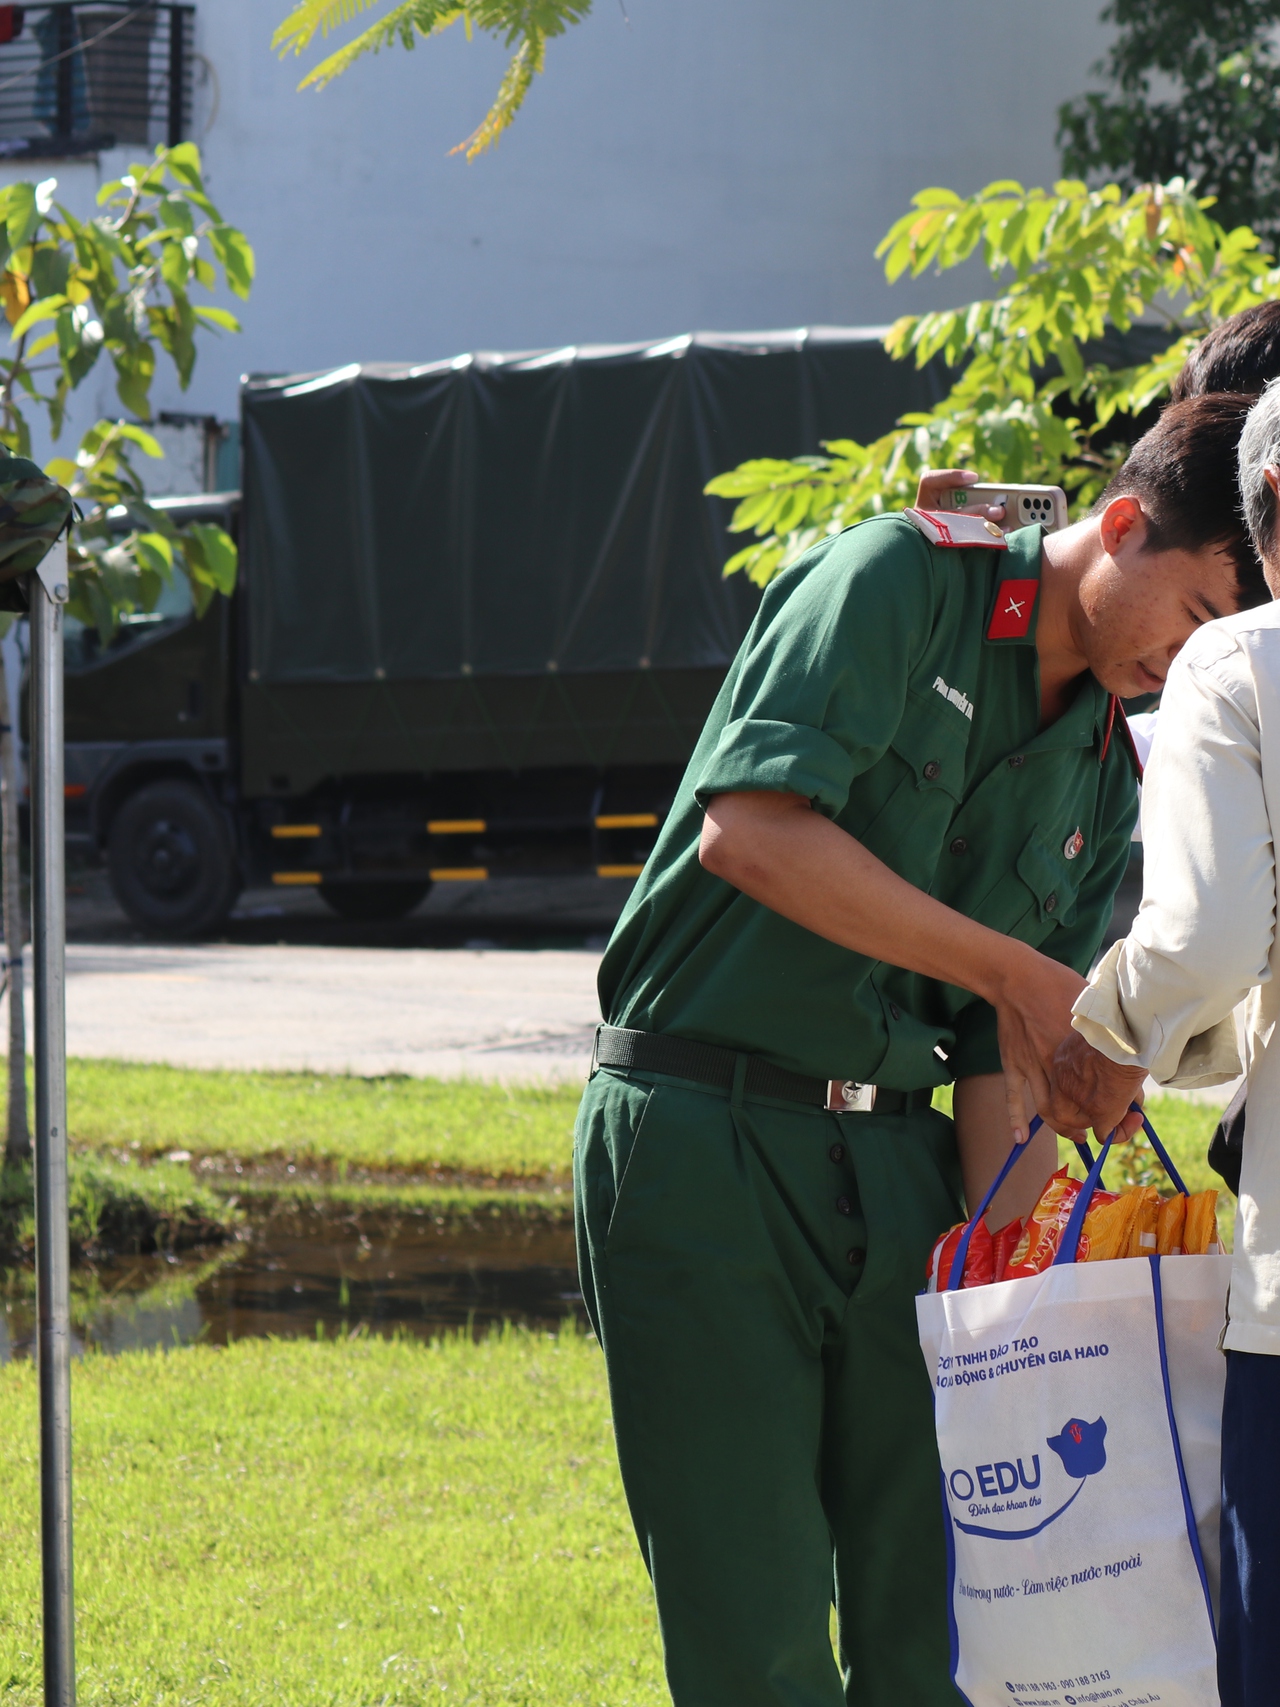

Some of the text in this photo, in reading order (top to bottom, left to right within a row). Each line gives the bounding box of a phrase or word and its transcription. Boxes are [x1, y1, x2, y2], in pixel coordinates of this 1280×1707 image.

[955, 1350, 988, 1367] TNHH
[989, 1343, 1009, 1360] ĐÀO
[1012, 1336, 1039, 1353] TẠO
[955, 1369, 987, 1386] ĐỘNG
[988, 1367, 995, 1379] &
[995, 1353, 1046, 1376] CHUYÊN
[1048, 1349, 1073, 1363] GIA
[1074, 1343, 1109, 1360] HAIO
[975, 1454, 1041, 1497] EDU
[1006, 1499, 1029, 1512] khoan
[1022, 1579, 1045, 1596] Làm
[1045, 1575, 1069, 1593] việc
[1071, 1565, 1102, 1585] nước
[1104, 1553, 1143, 1578] ngoài
[1039, 1680, 1057, 1691] 1963
[1060, 1678, 1075, 1689] 090
[1075, 1675, 1090, 1686] 188
[1090, 1669, 1111, 1683] 3163
[1075, 1687, 1123, 1703] info@haio.vn
